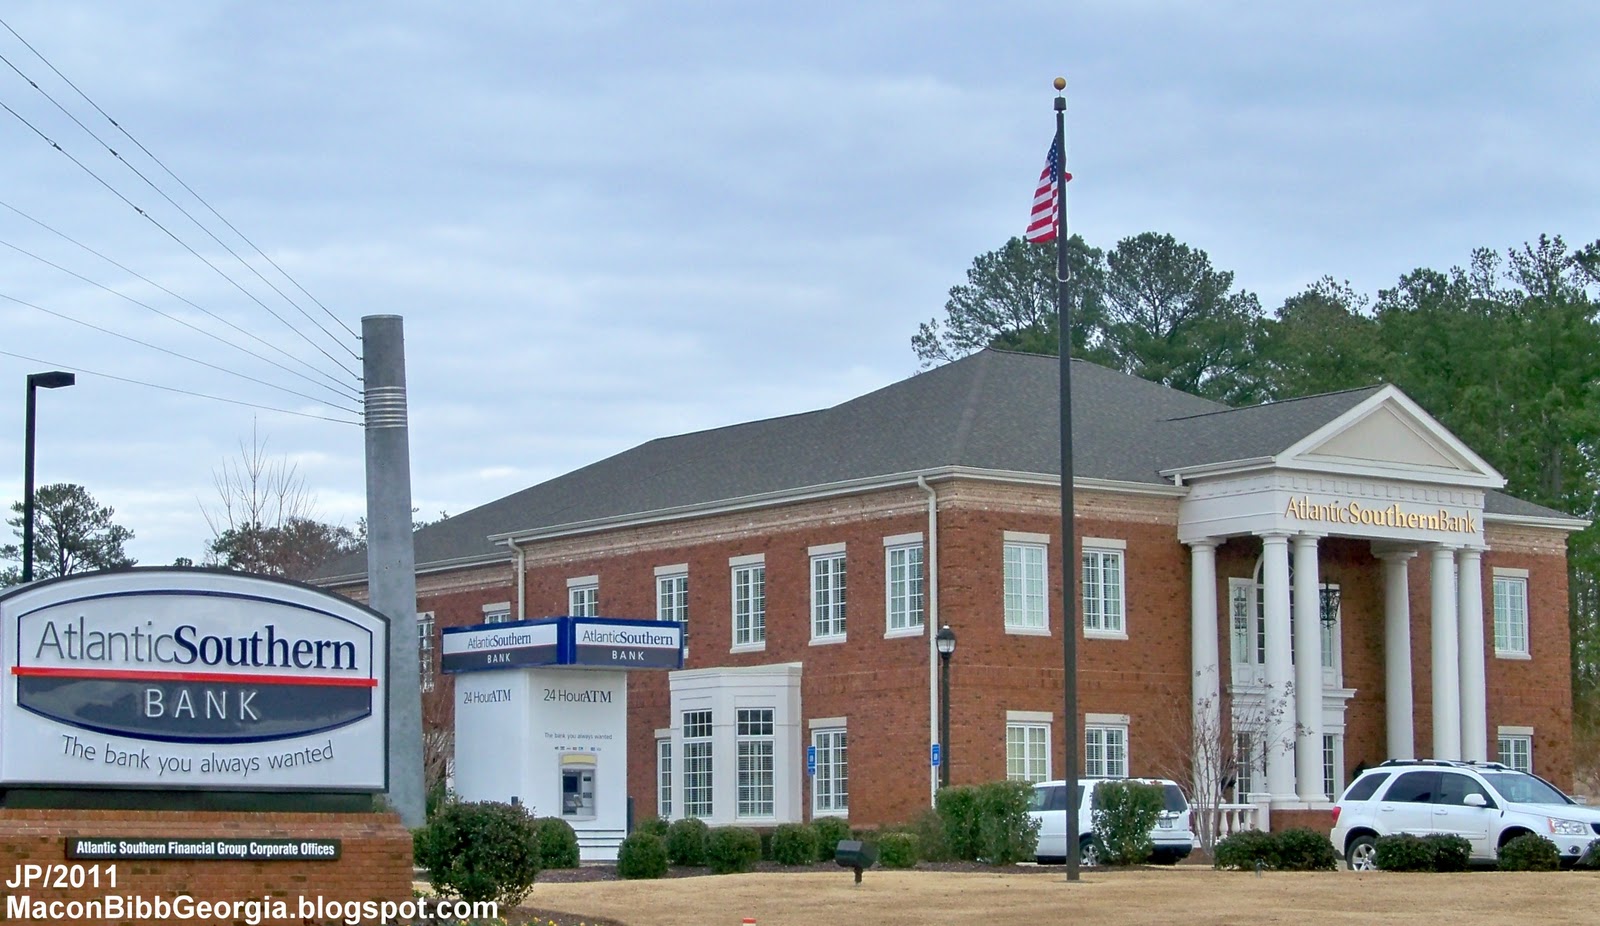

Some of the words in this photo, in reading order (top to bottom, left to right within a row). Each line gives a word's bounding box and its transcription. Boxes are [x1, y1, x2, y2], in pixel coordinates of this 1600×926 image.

[35, 616, 358, 670] AtlanticSouthern
[487, 652, 511, 664] BANK
[611, 650, 645, 661] BANK
[463, 691, 473, 704] 24
[543, 688, 556, 702] 24
[145, 688, 258, 721] BANK
[62, 734, 97, 761] The
[104, 743, 151, 769] bank
[158, 753, 192, 776] you
[200, 752, 260, 776] always
[267, 740, 334, 769] wanted
[76, 841, 117, 854] Atlantic
[119, 841, 166, 855] Southern
[168, 842, 215, 855] Financial
[217, 842, 248, 857] Group
[250, 842, 299, 857] Corporate
[300, 842, 335, 856] Offices
